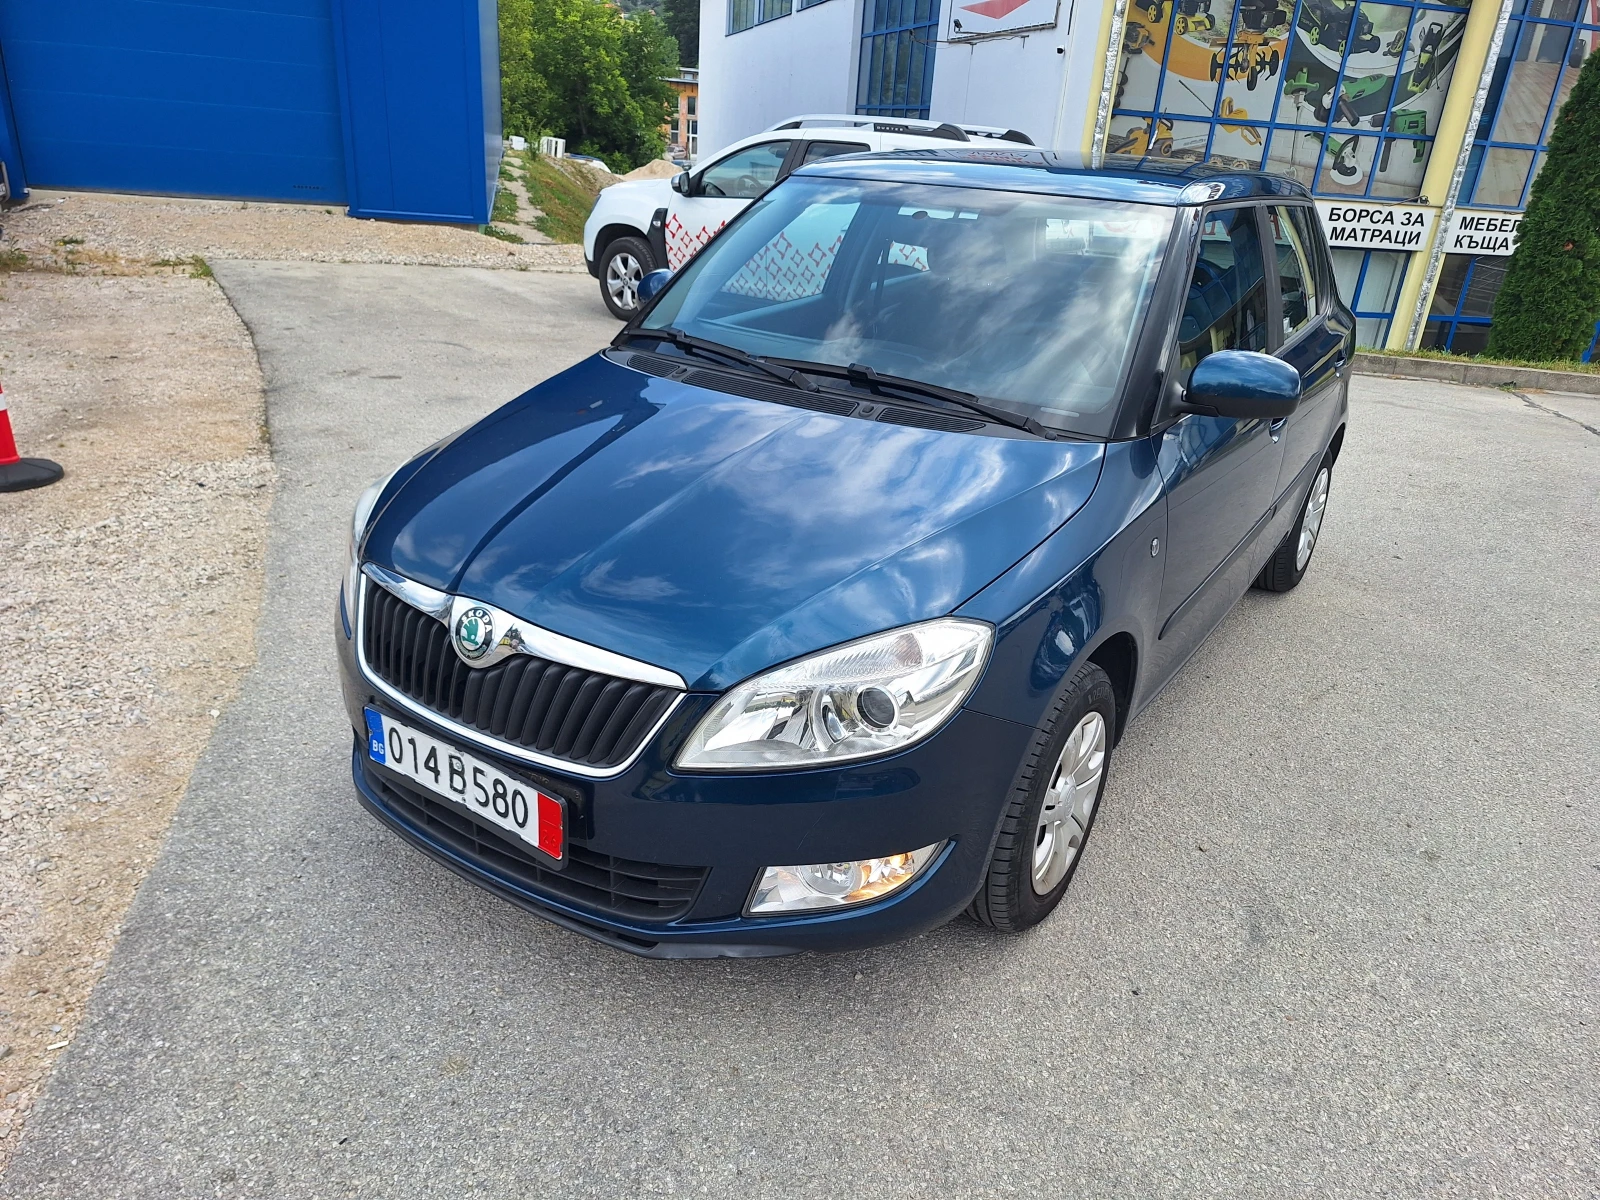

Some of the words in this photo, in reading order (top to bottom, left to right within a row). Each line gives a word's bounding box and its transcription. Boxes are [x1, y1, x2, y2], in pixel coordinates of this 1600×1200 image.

[1328, 207, 1395, 226] БОРСА
[1400, 211, 1425, 227] ЗА
[1329, 226, 1422, 247] МАТРАЦИ
[1453, 234, 1509, 253] КЪЩА
[372, 739, 384, 755] BG
